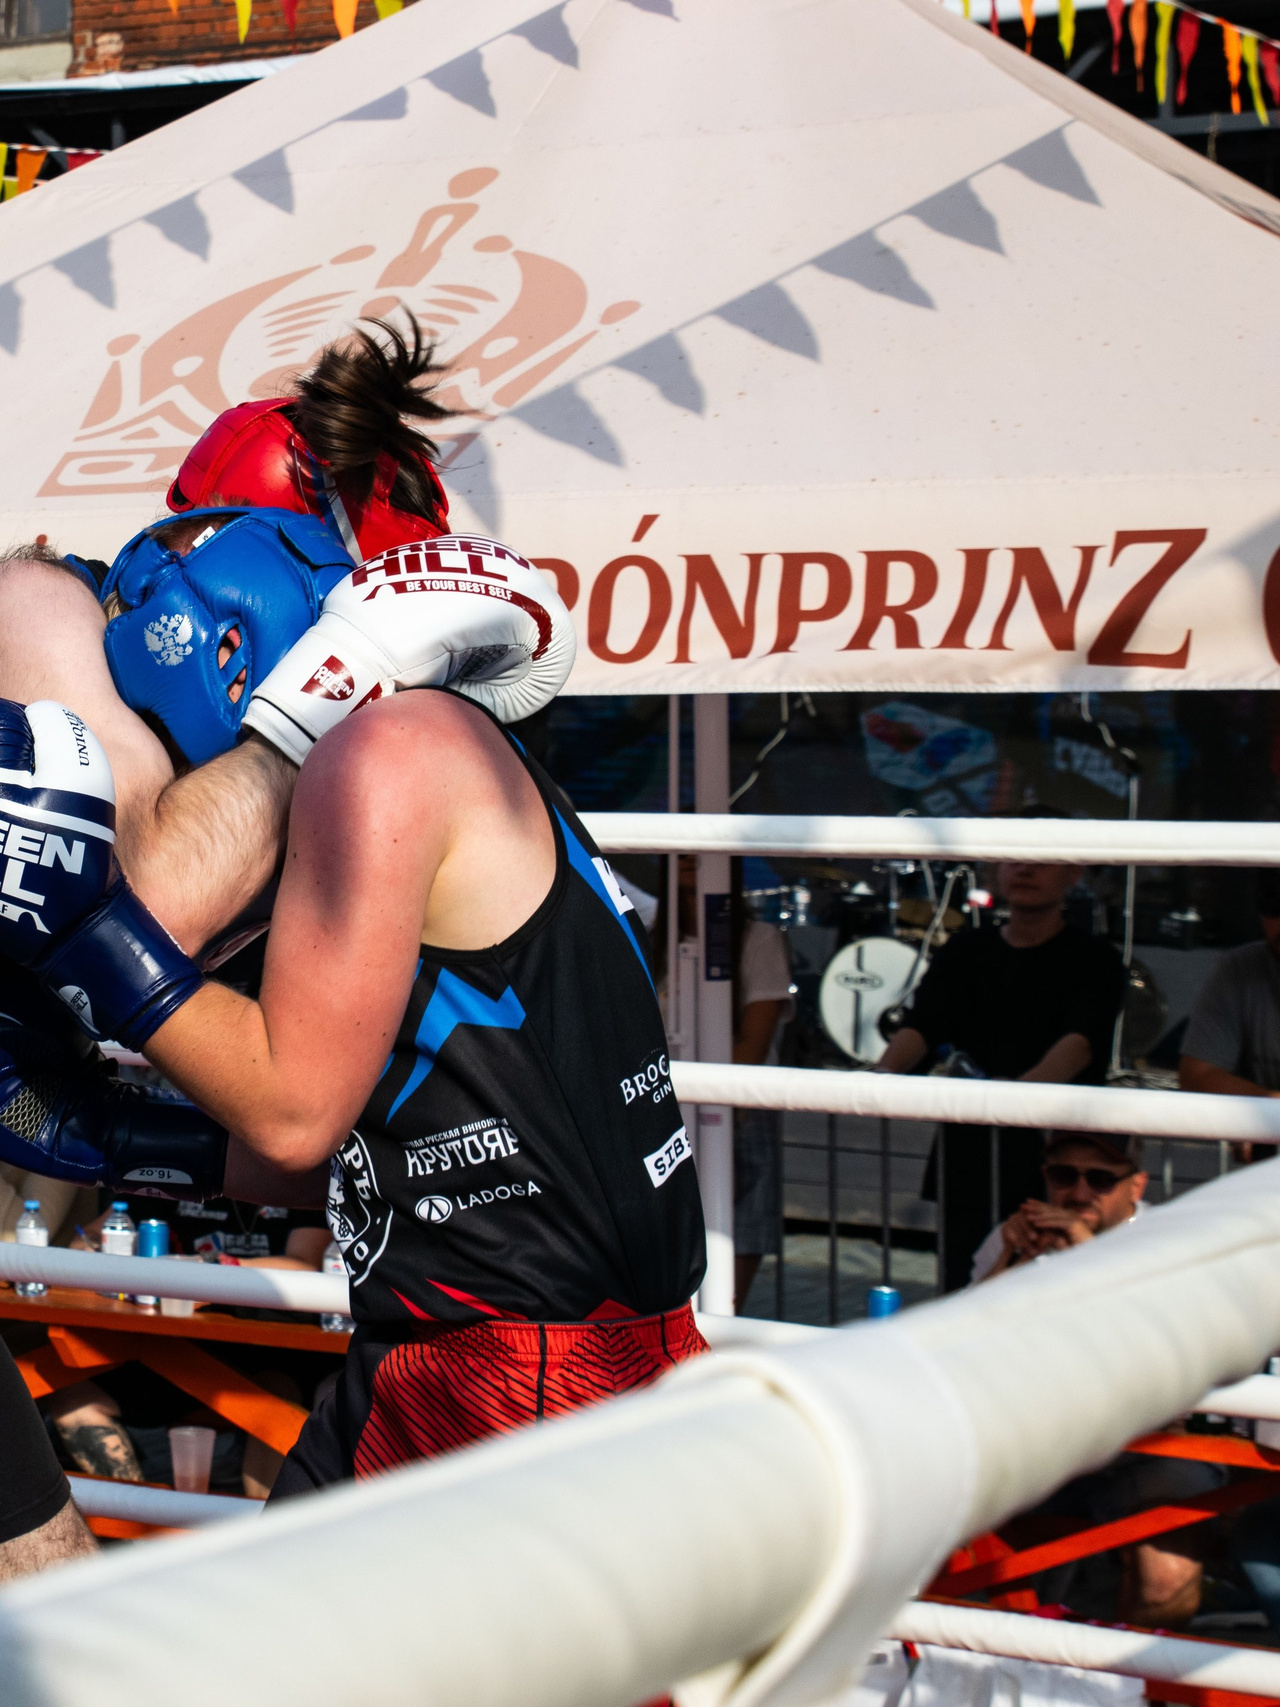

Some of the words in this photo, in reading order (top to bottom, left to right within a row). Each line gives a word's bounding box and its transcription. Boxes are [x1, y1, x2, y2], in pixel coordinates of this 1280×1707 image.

[352, 552, 508, 587] HILL
[405, 580, 421, 592] BE
[423, 580, 456, 591] YOUR
[457, 580, 486, 594] BEST
[487, 586, 513, 601] SELF
[652, 1081, 673, 1104] GIN
[425, 1127, 461, 1145] РУССКАЯ
[404, 1127, 520, 1178] КРУТОЯР
[456, 1180, 542, 1211] LADOGA
